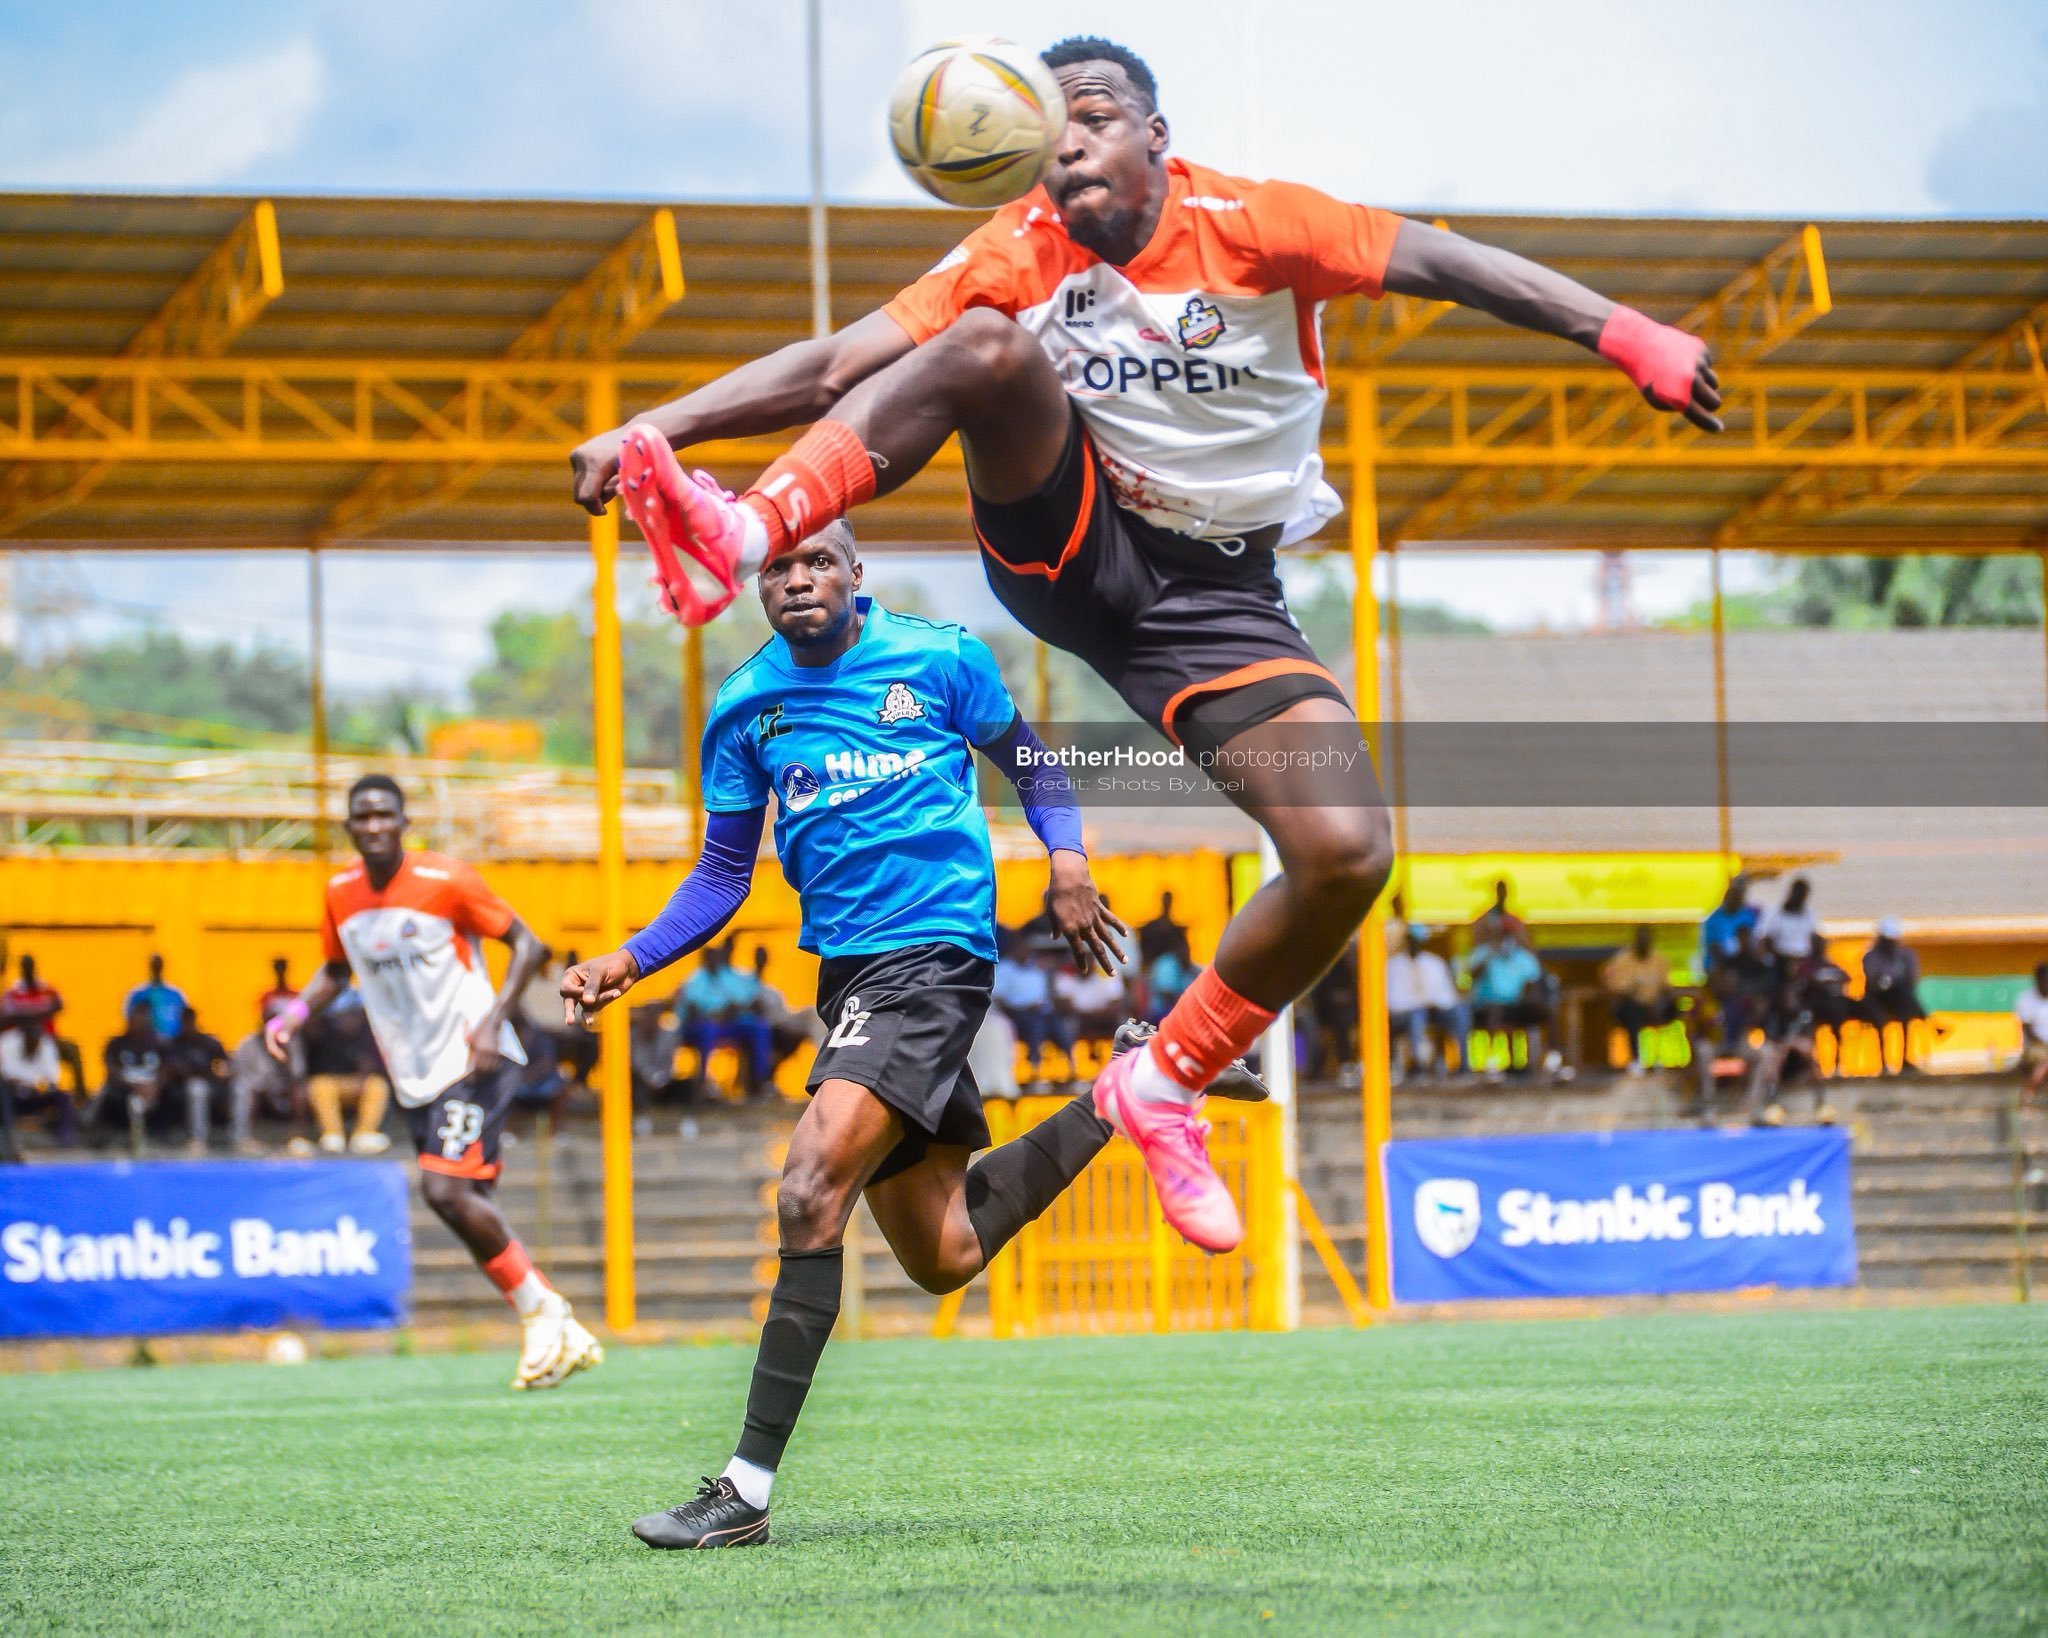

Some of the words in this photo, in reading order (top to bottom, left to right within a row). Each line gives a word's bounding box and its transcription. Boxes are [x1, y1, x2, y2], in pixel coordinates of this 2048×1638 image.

[437, 1100, 484, 1145] 33
[1498, 1184, 1692, 1247] Stanbic
[1698, 1179, 1826, 1239] Bank
[1, 1218, 222, 1283] Stanbic
[230, 1215, 380, 1279] Bank
